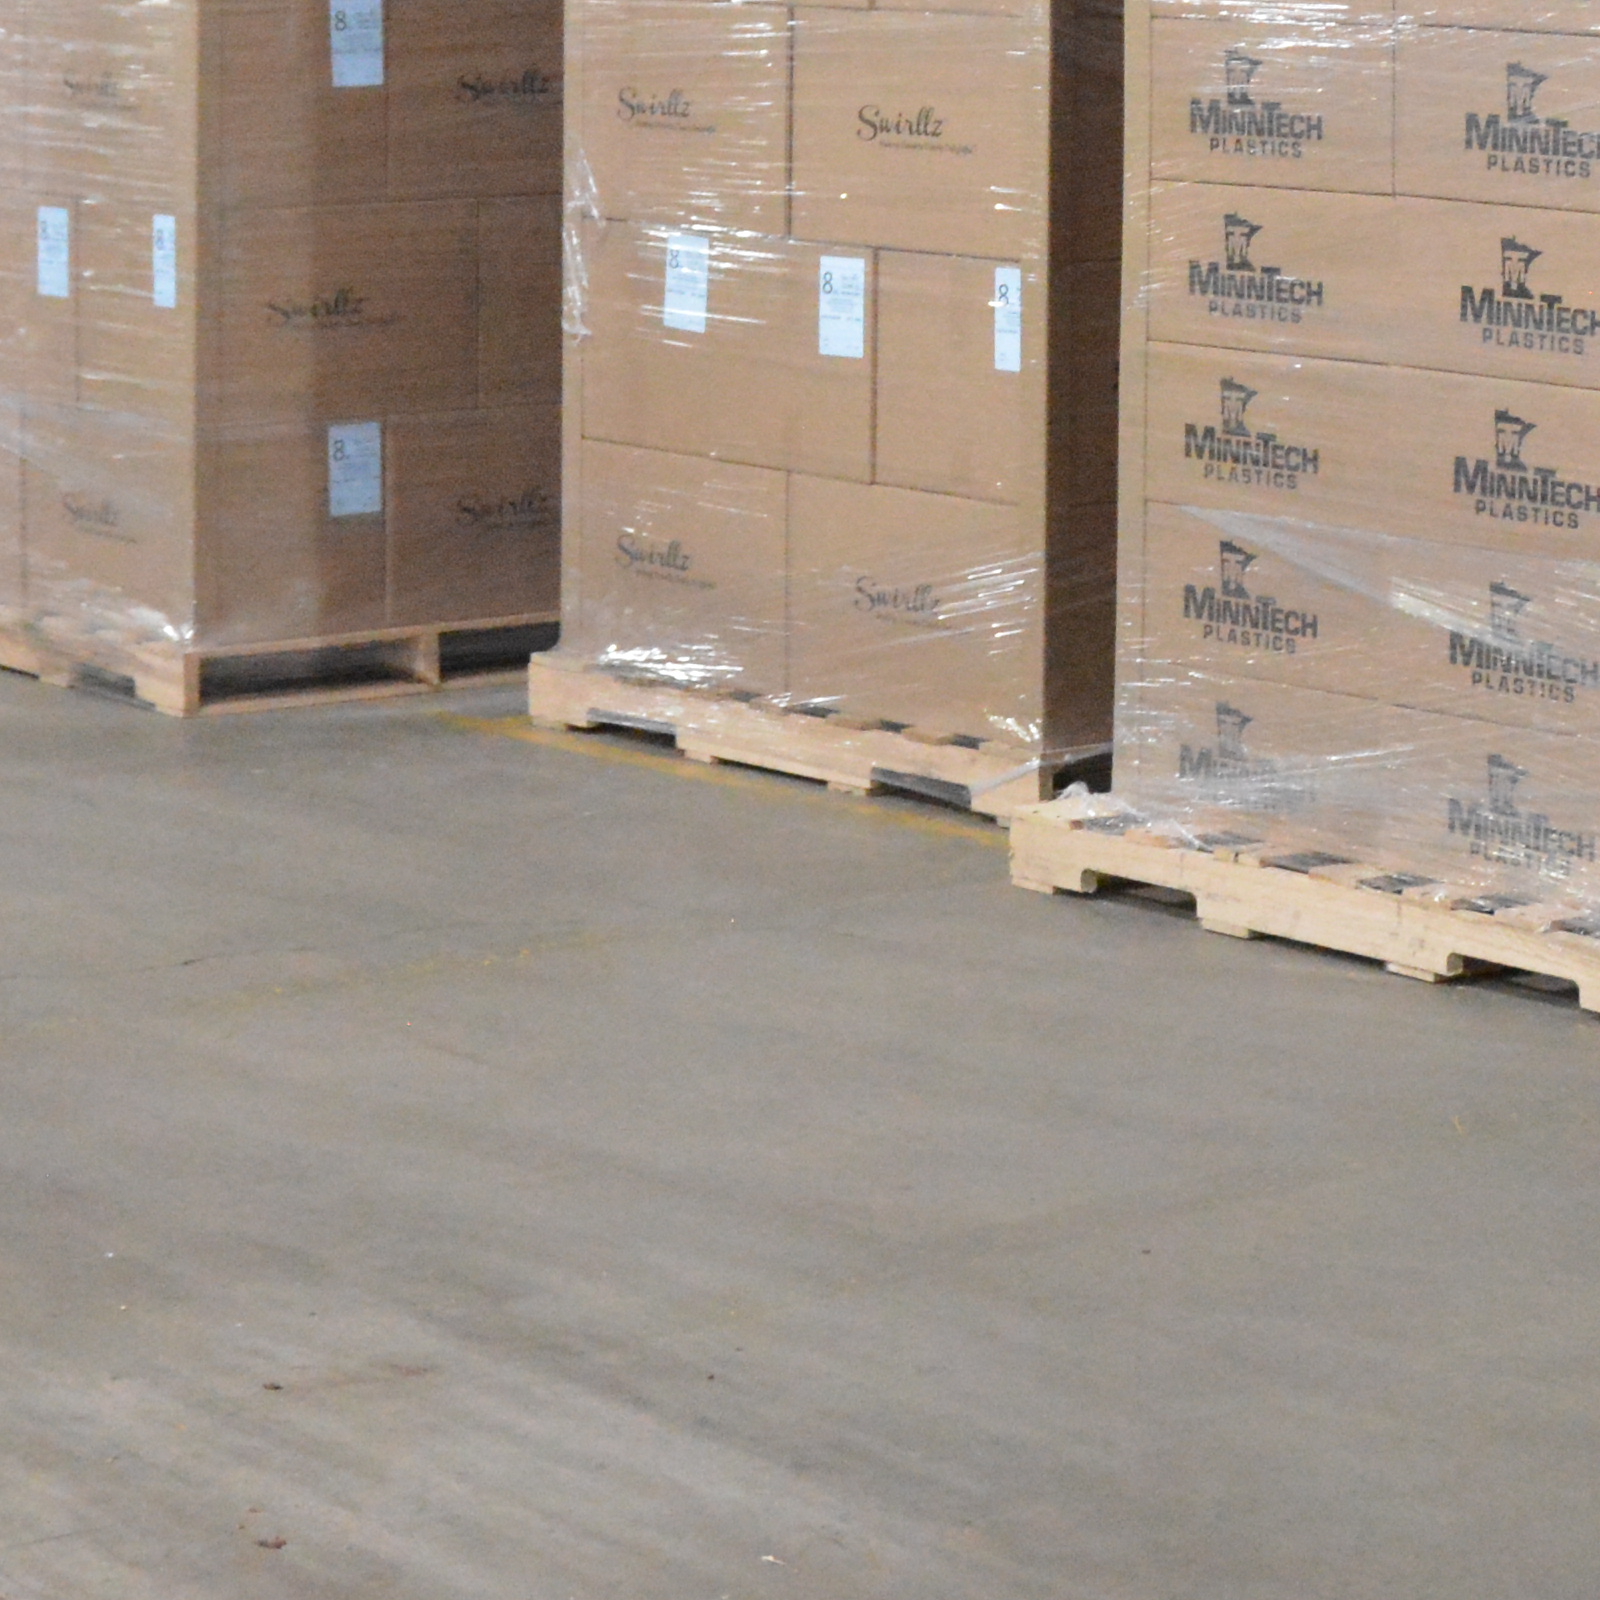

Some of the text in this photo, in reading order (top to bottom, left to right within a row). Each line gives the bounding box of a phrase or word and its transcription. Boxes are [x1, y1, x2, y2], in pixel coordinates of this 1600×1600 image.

[334, 10, 347, 32] 8
[1210, 138, 1301, 158] PLASTICS
[1487, 156, 1591, 179] PLASTICS
[822, 272, 833, 295] 8
[998, 284, 1010, 306] 8
[1208, 301, 1301, 324] PLASTICS
[1482, 327, 1585, 355] PLASTICS
[333, 438, 345, 461] 8
[1204, 462, 1298, 490] PLASTICS
[1475, 499, 1579, 530] PLASTICS
[1203, 624, 1296, 654] PLASTICS
[1472, 671, 1576, 703] PLASTICS
